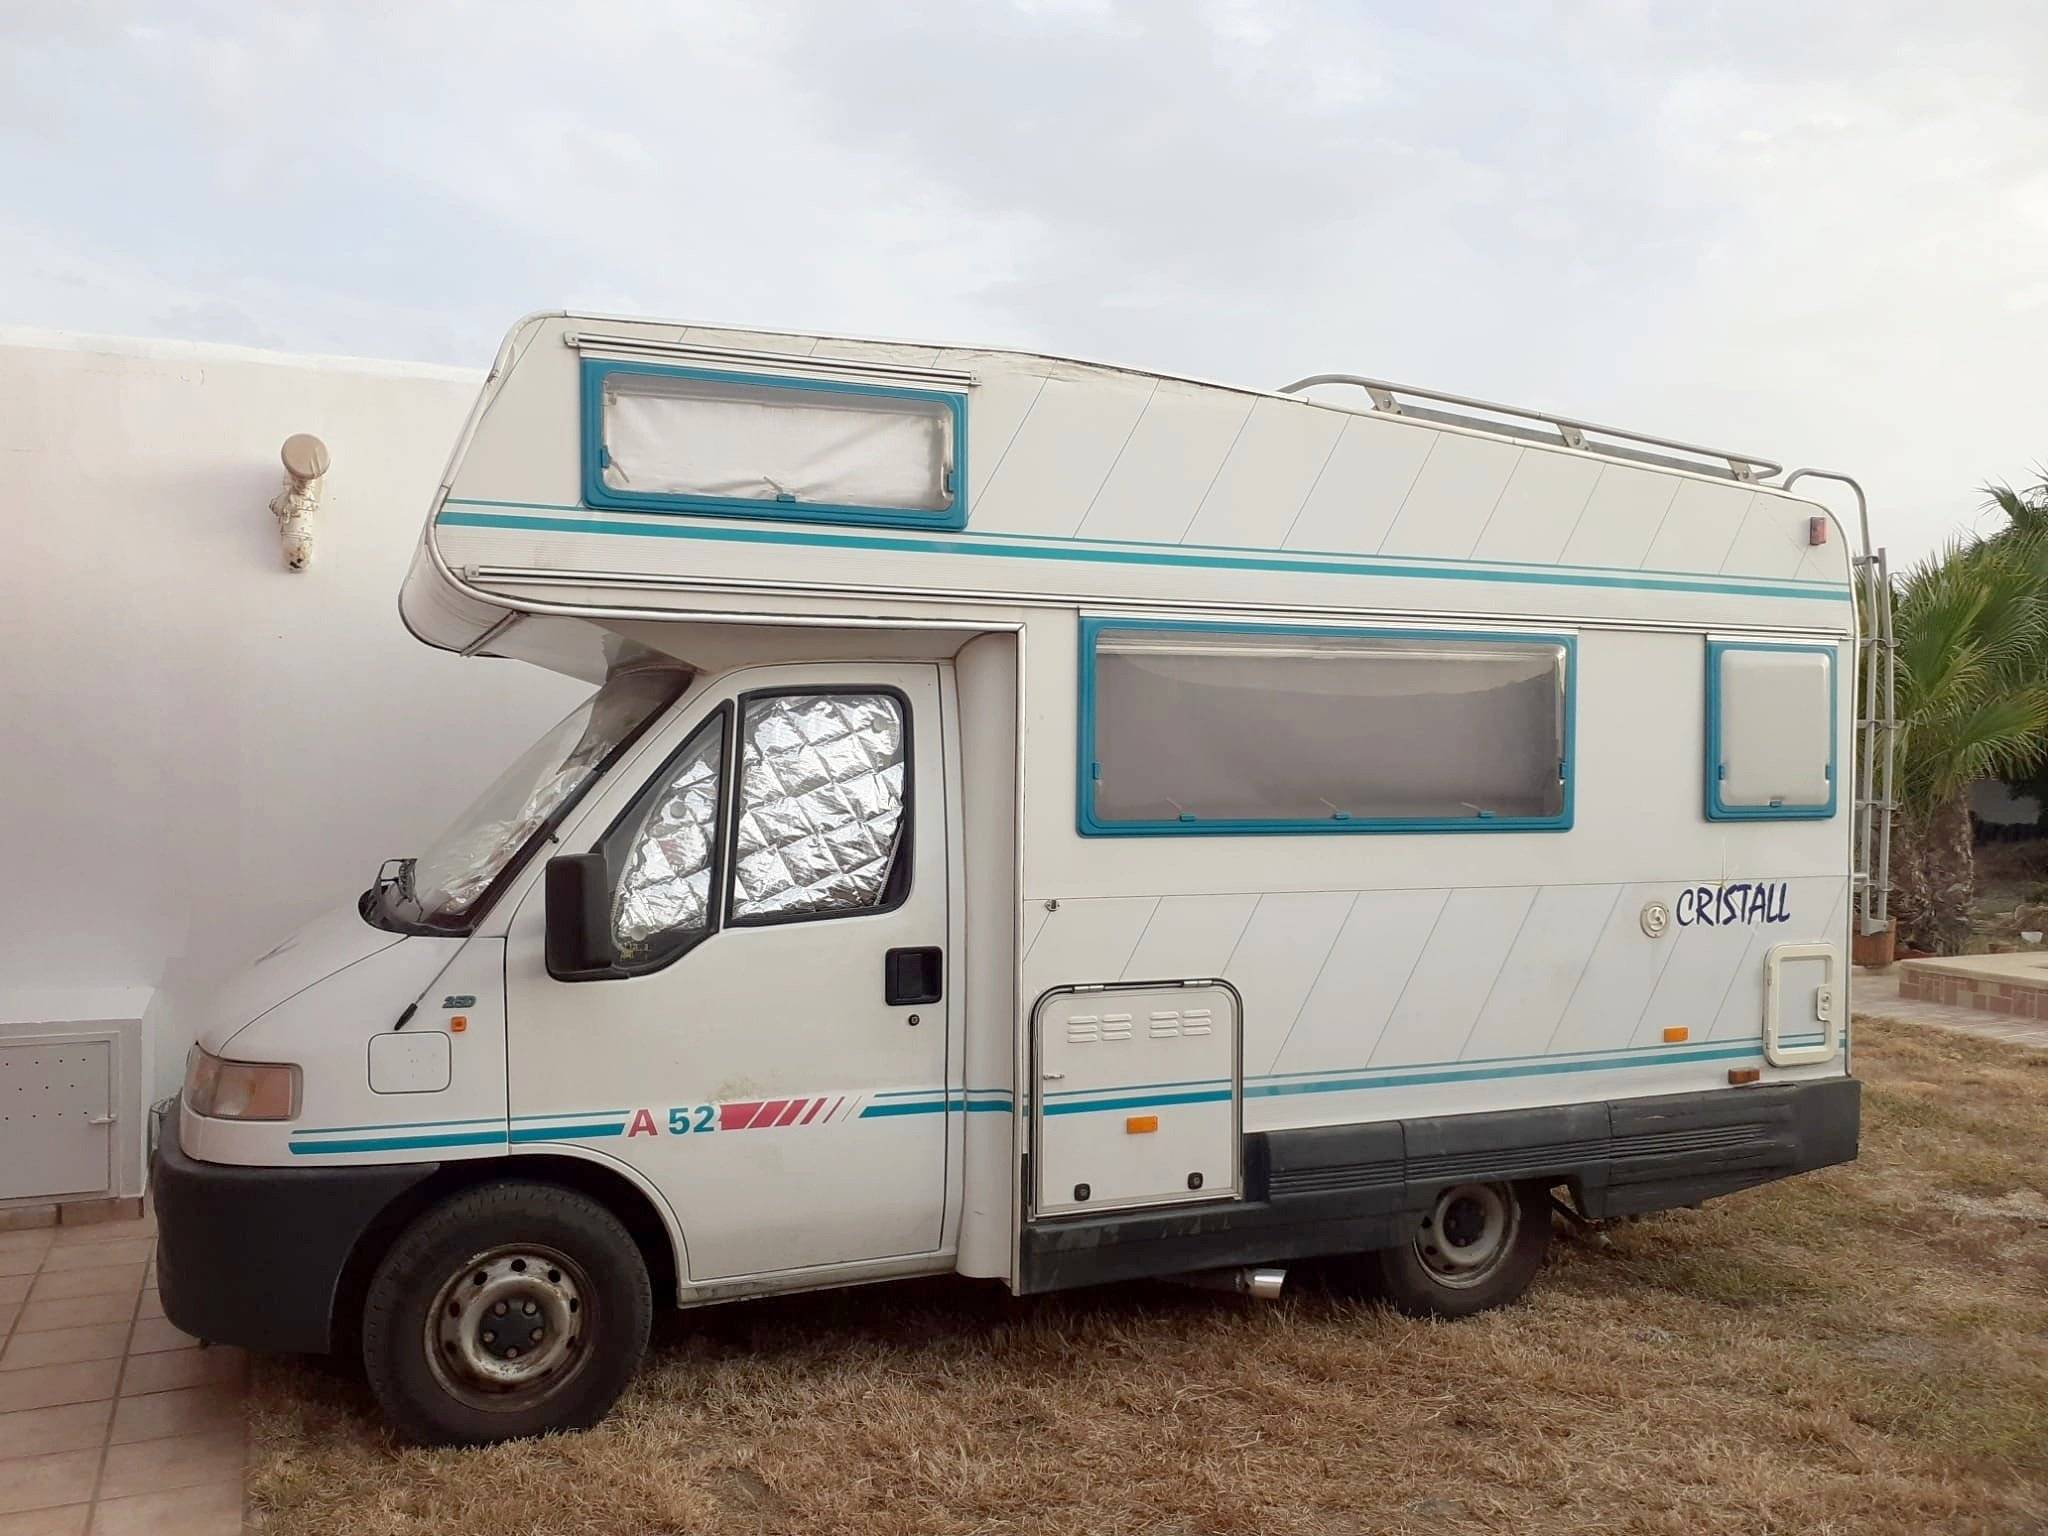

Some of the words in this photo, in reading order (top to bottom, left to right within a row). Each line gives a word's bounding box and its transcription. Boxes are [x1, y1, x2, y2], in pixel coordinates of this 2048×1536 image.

[1676, 882, 1790, 926] CRISTALL
[627, 1109, 658, 1138] A
[669, 1105, 715, 1135] 52
